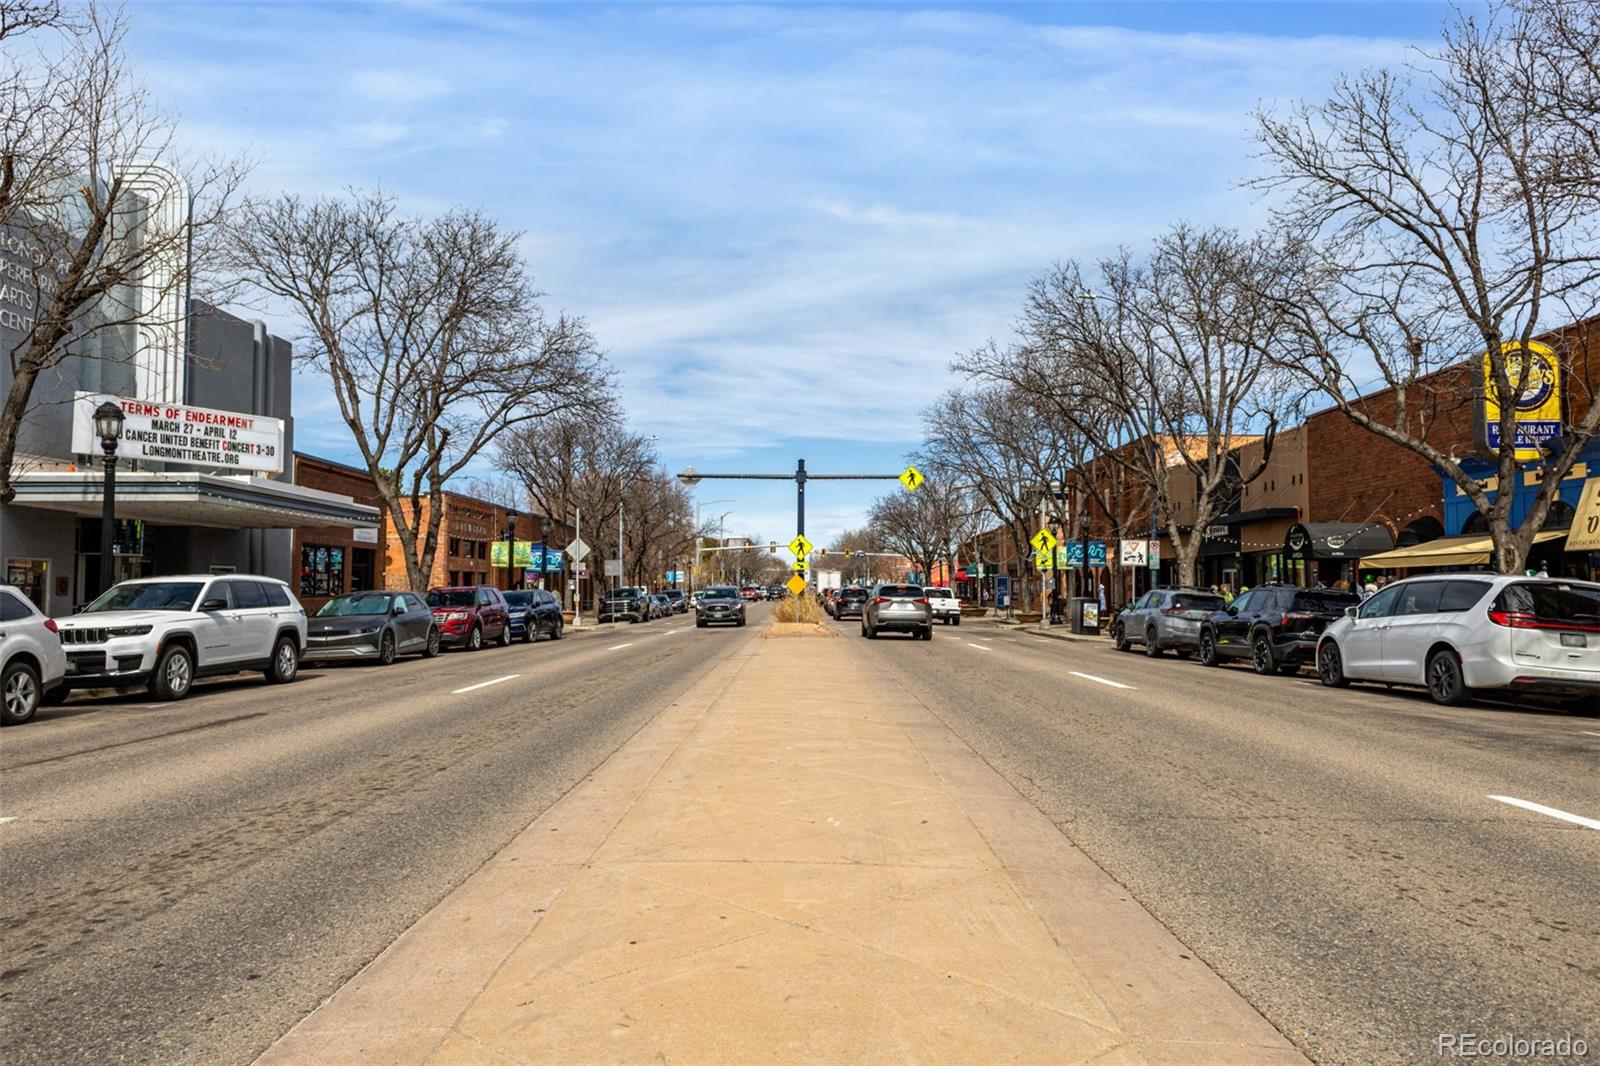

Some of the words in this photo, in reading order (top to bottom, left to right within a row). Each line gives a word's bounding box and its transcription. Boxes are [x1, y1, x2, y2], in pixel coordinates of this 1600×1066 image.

[0, 284, 33, 310] ARTS
[120, 401, 160, 417] TERMS
[165, 408, 180, 420] OF
[185, 410, 254, 429] ENDEARMENT
[125, 428, 158, 443] CANCER
[160, 433, 188, 447] UNITED
[190, 437, 220, 450] BENEFIT
[221, 440, 255, 454] CONCERT
[256, 444, 275, 457] 3-30
[151, 419, 180, 433] MARCH
[183, 423, 194, 435] 27
[203, 426, 226, 439] APRIL
[229, 429, 238, 440] 12
[142, 444, 240, 465] LONGMONTTHEATRE.ORG
